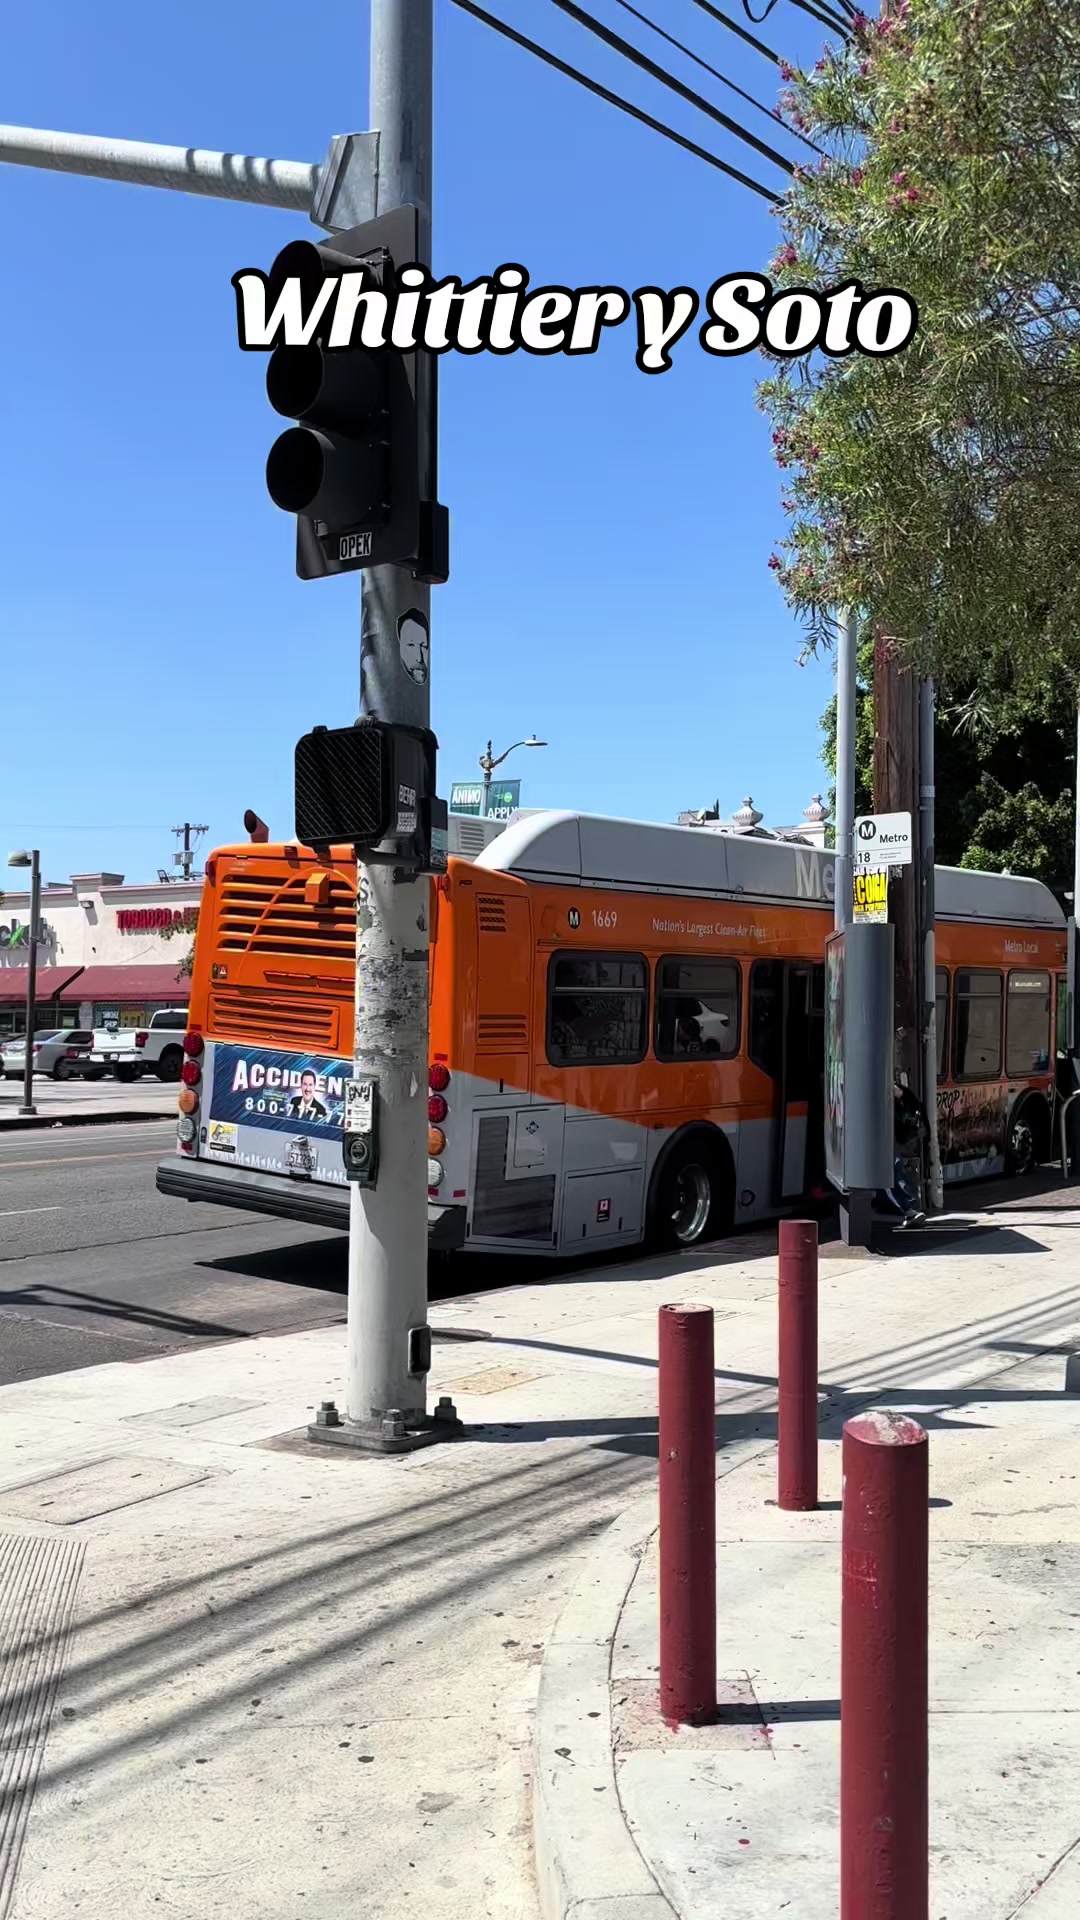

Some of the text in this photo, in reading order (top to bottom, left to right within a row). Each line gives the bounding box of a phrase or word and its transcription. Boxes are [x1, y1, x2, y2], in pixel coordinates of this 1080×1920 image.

[340, 533, 371, 559] OPEK
[860, 822, 875, 838] M
[880, 833, 908, 843] Metro
[858, 852, 871, 863] 18
[794, 848, 835, 899] Me
[569, 909, 617, 928] M 1669
[653, 918, 684, 933] Nation's
[687, 923, 713, 938] Largest
[232, 1059, 345, 1096] ACCIDEN
[245, 1097, 344, 1126] 800-777-77
